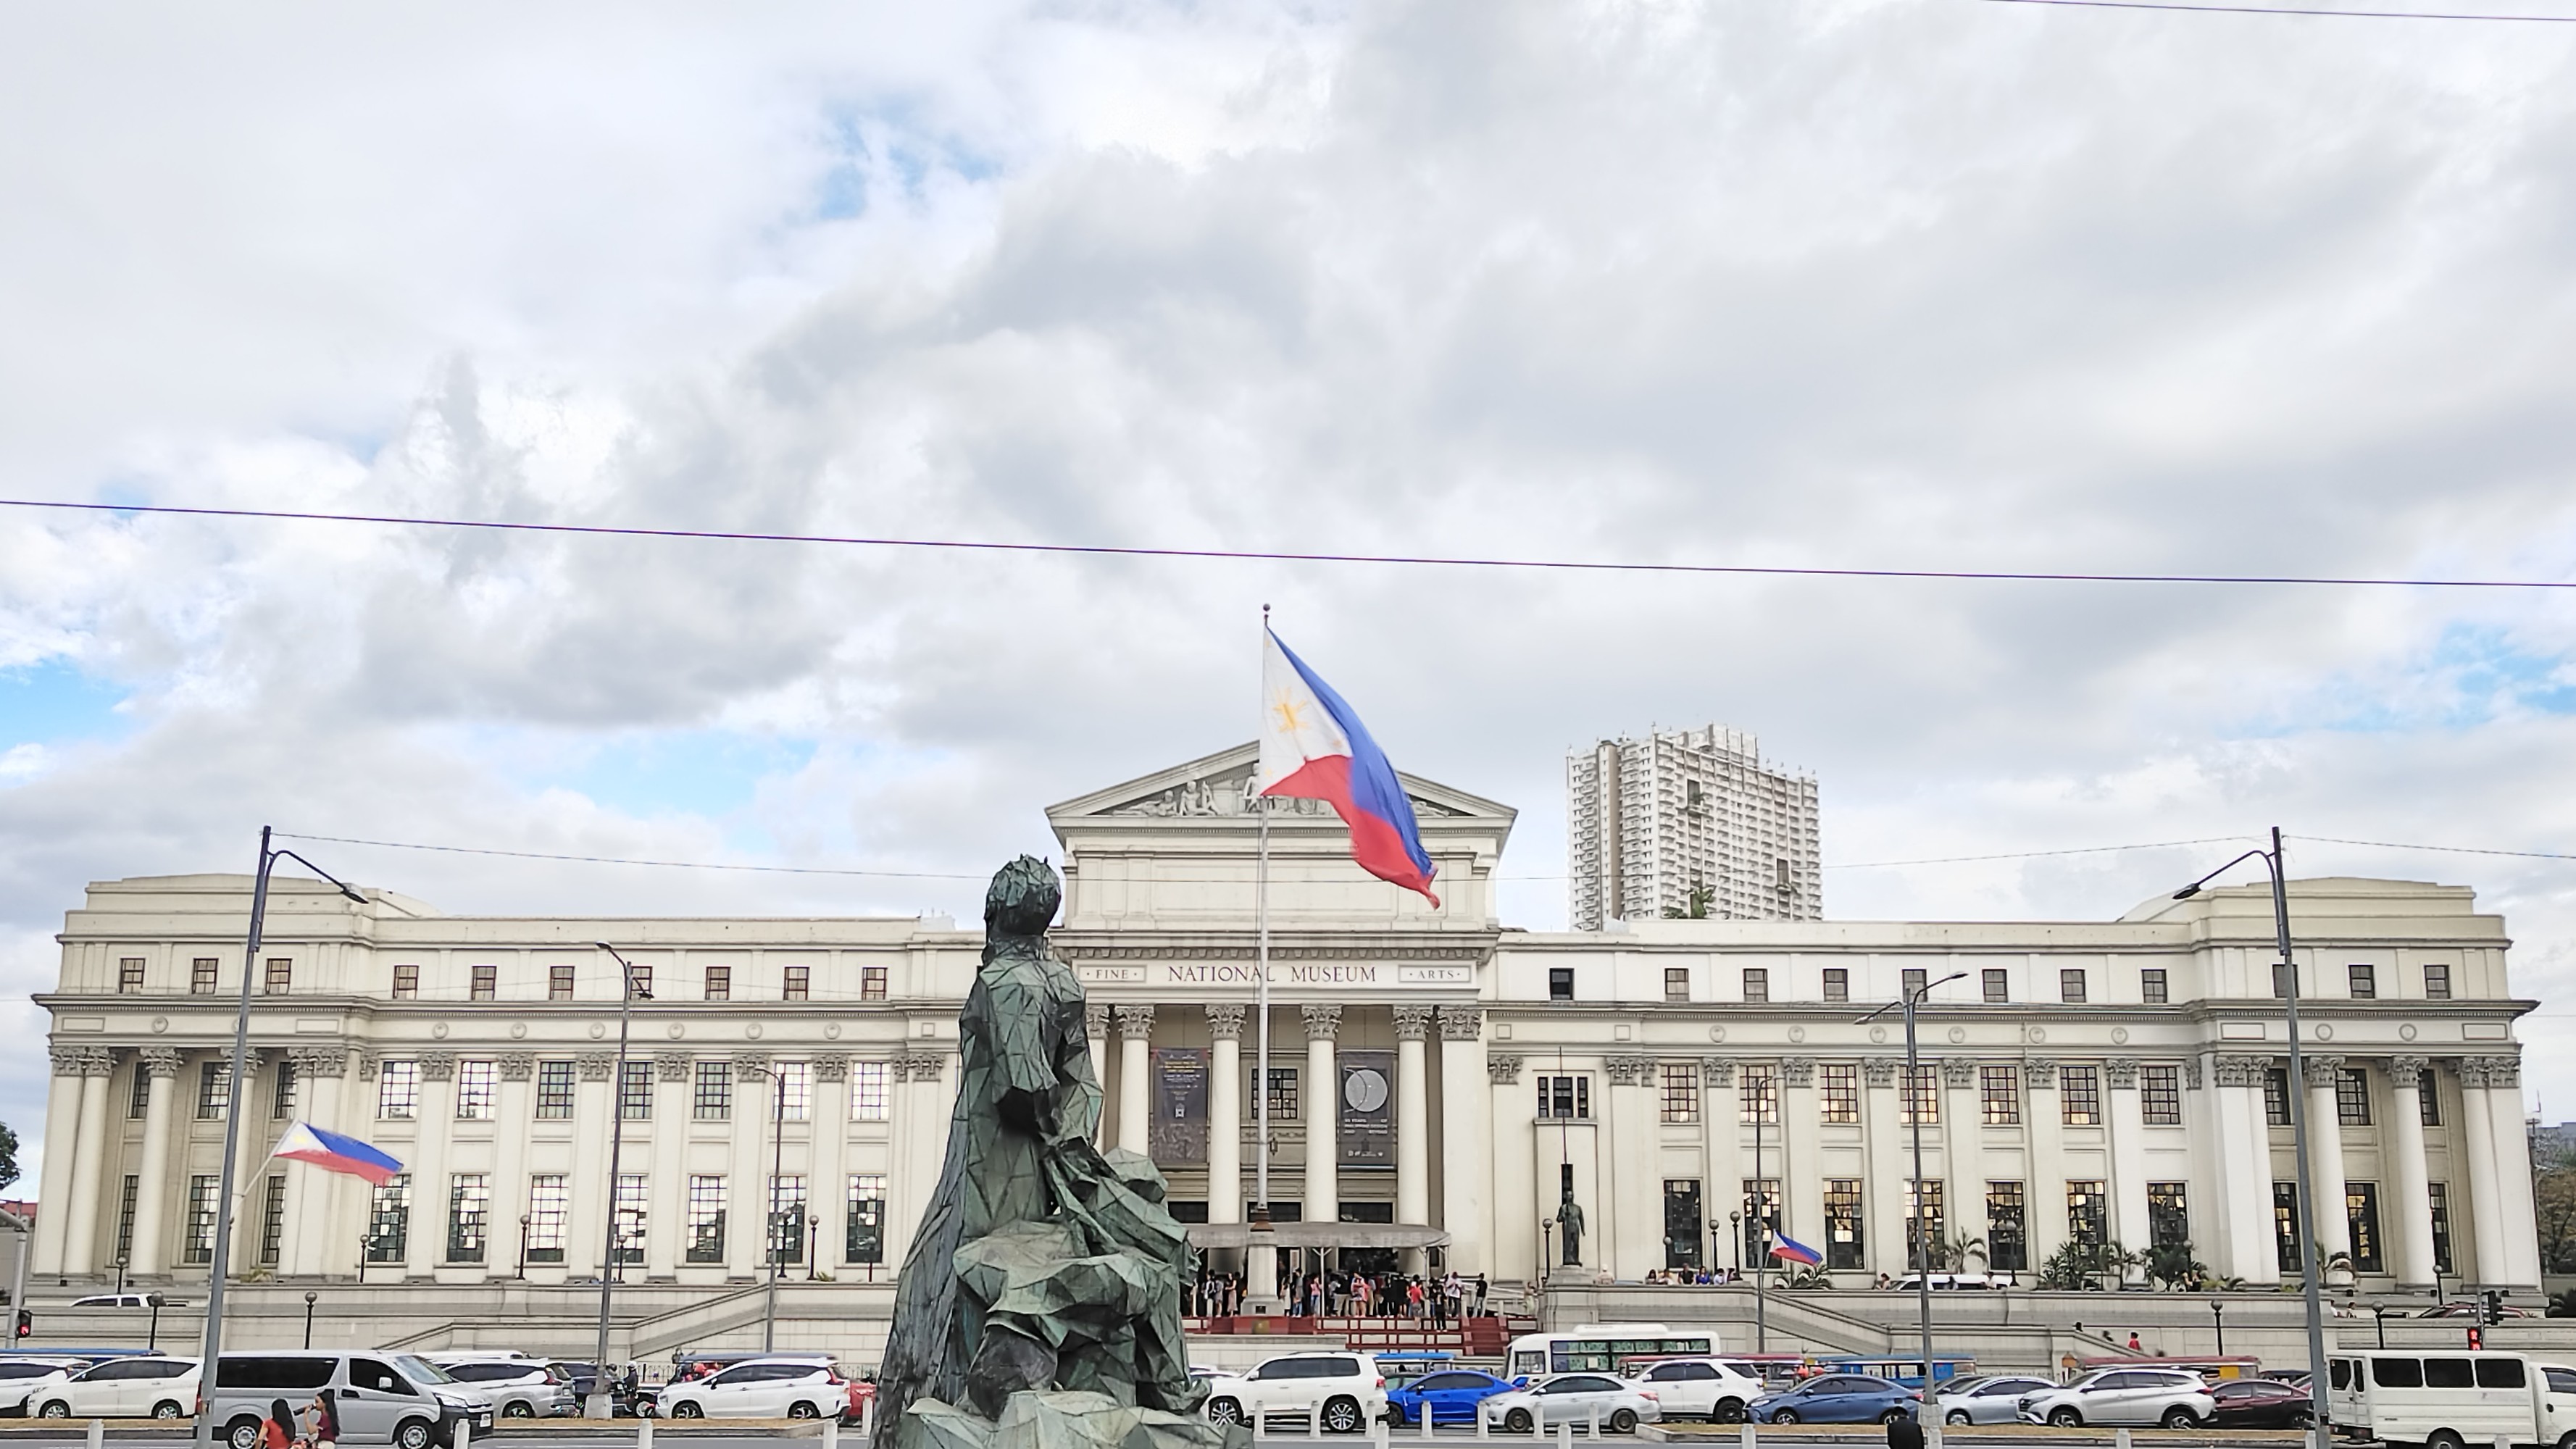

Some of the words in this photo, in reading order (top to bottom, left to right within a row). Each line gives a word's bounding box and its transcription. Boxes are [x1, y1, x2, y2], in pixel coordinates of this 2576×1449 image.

[1096, 969, 1129, 980] FINE
[1168, 966, 1276, 982] NATIONAL
[1291, 966, 1376, 982] MUSEUM
[1417, 969, 1454, 980] ARTS
